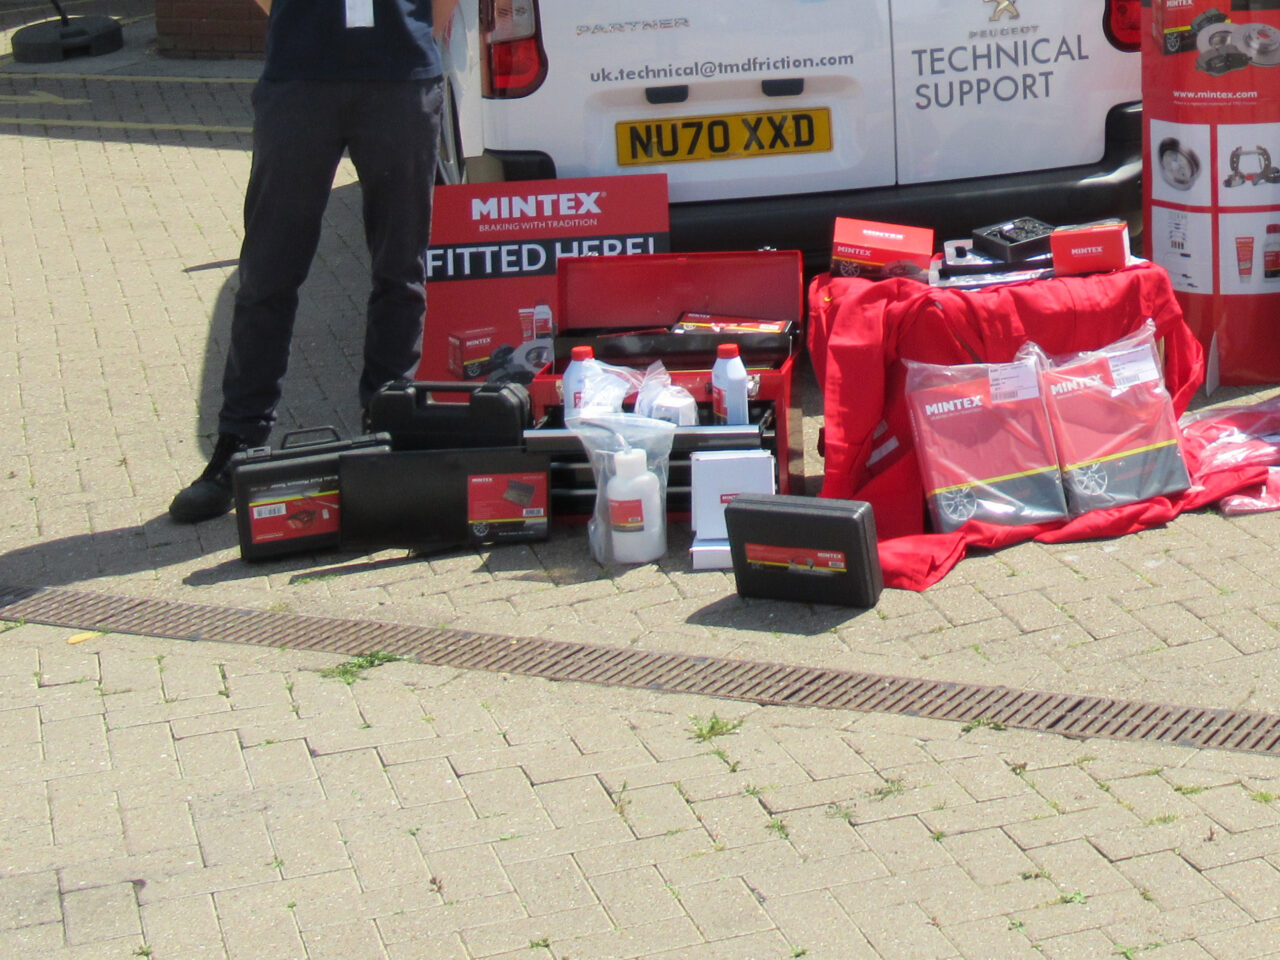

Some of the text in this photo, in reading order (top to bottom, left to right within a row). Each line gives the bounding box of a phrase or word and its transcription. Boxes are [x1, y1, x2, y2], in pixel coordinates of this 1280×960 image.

[576, 17, 690, 36] PARTNER
[968, 25, 1040, 39] PEUGEOT
[911, 34, 1090, 76] TECHNICAL
[589, 53, 854, 83] uk.technical@tmdfriction.com
[915, 71, 1054, 110] SUPPORT
[1173, 90, 1258, 99] www.mintex.com
[630, 113, 815, 160] NU70 XXD
[471, 192, 602, 221] MINTEX
[479, 218, 597, 232] BRAKING WITH TRADITION
[426, 243, 547, 277] FITTED
[837, 246, 872, 257] MINTEX
[1071, 246, 1103, 255] MINTEX
[1050, 374, 1105, 396] MINTEX
[925, 395, 984, 416] MINTEX
